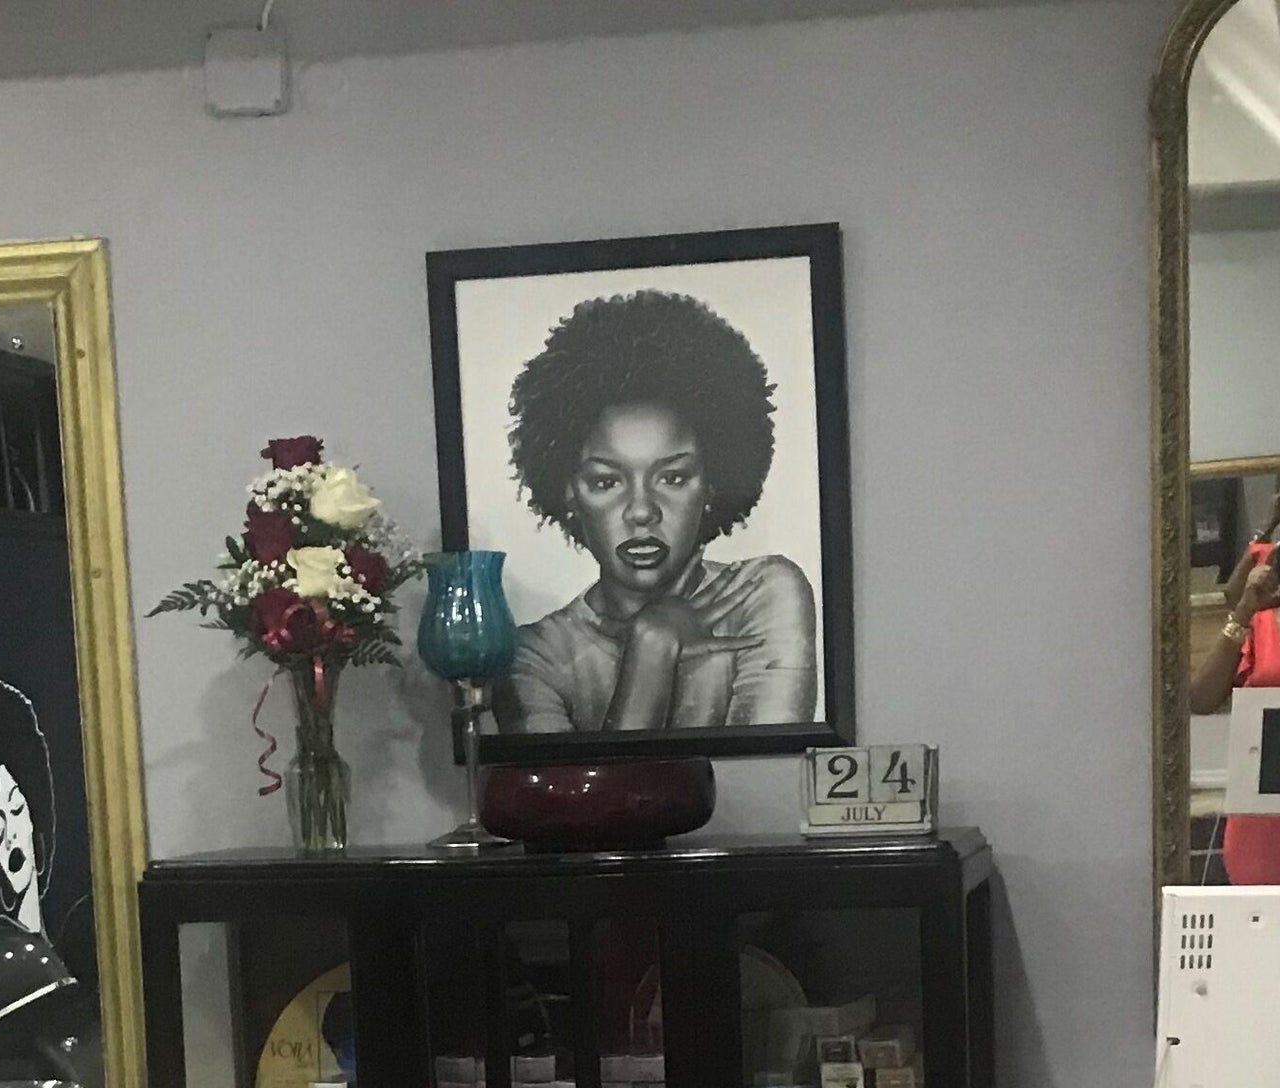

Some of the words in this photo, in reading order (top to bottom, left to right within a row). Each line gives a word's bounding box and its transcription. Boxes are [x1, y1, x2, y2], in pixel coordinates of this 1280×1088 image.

[827, 754, 859, 799] 2
[881, 750, 916, 794] 4
[840, 805, 887, 821] JULY
